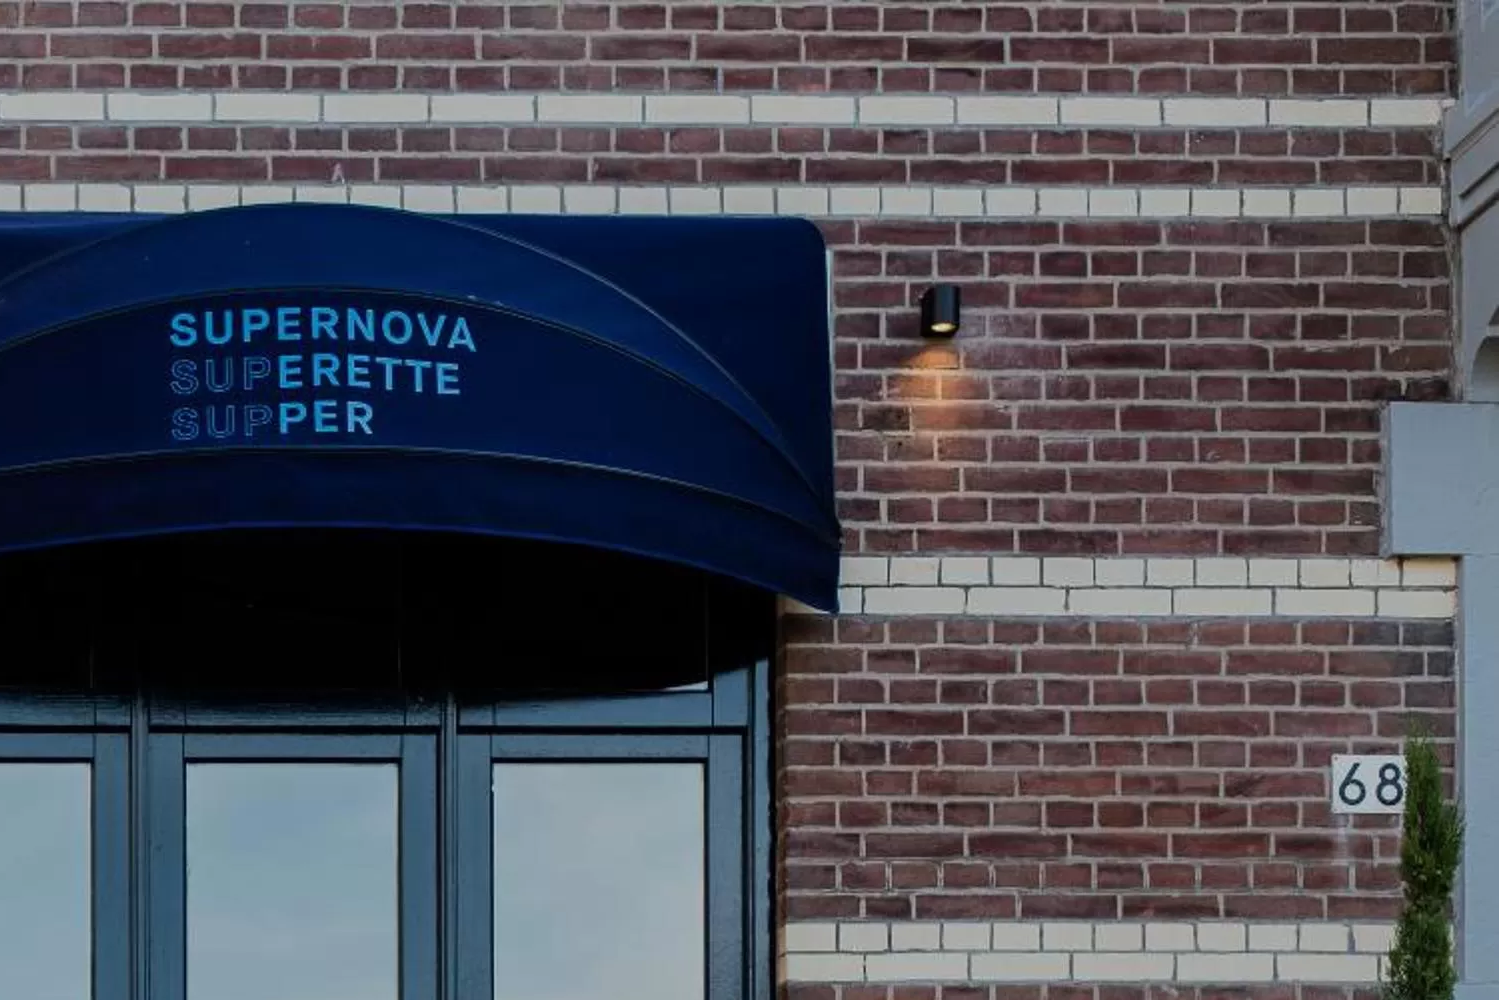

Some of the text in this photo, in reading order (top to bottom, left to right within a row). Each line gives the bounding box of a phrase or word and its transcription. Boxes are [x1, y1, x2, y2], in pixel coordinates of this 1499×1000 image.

[170, 307, 477, 352] SUPERNOVA
[170, 353, 461, 395] SUPERETTE
[171, 400, 374, 440] SUPPER
[1339, 763, 1403, 806] 68
